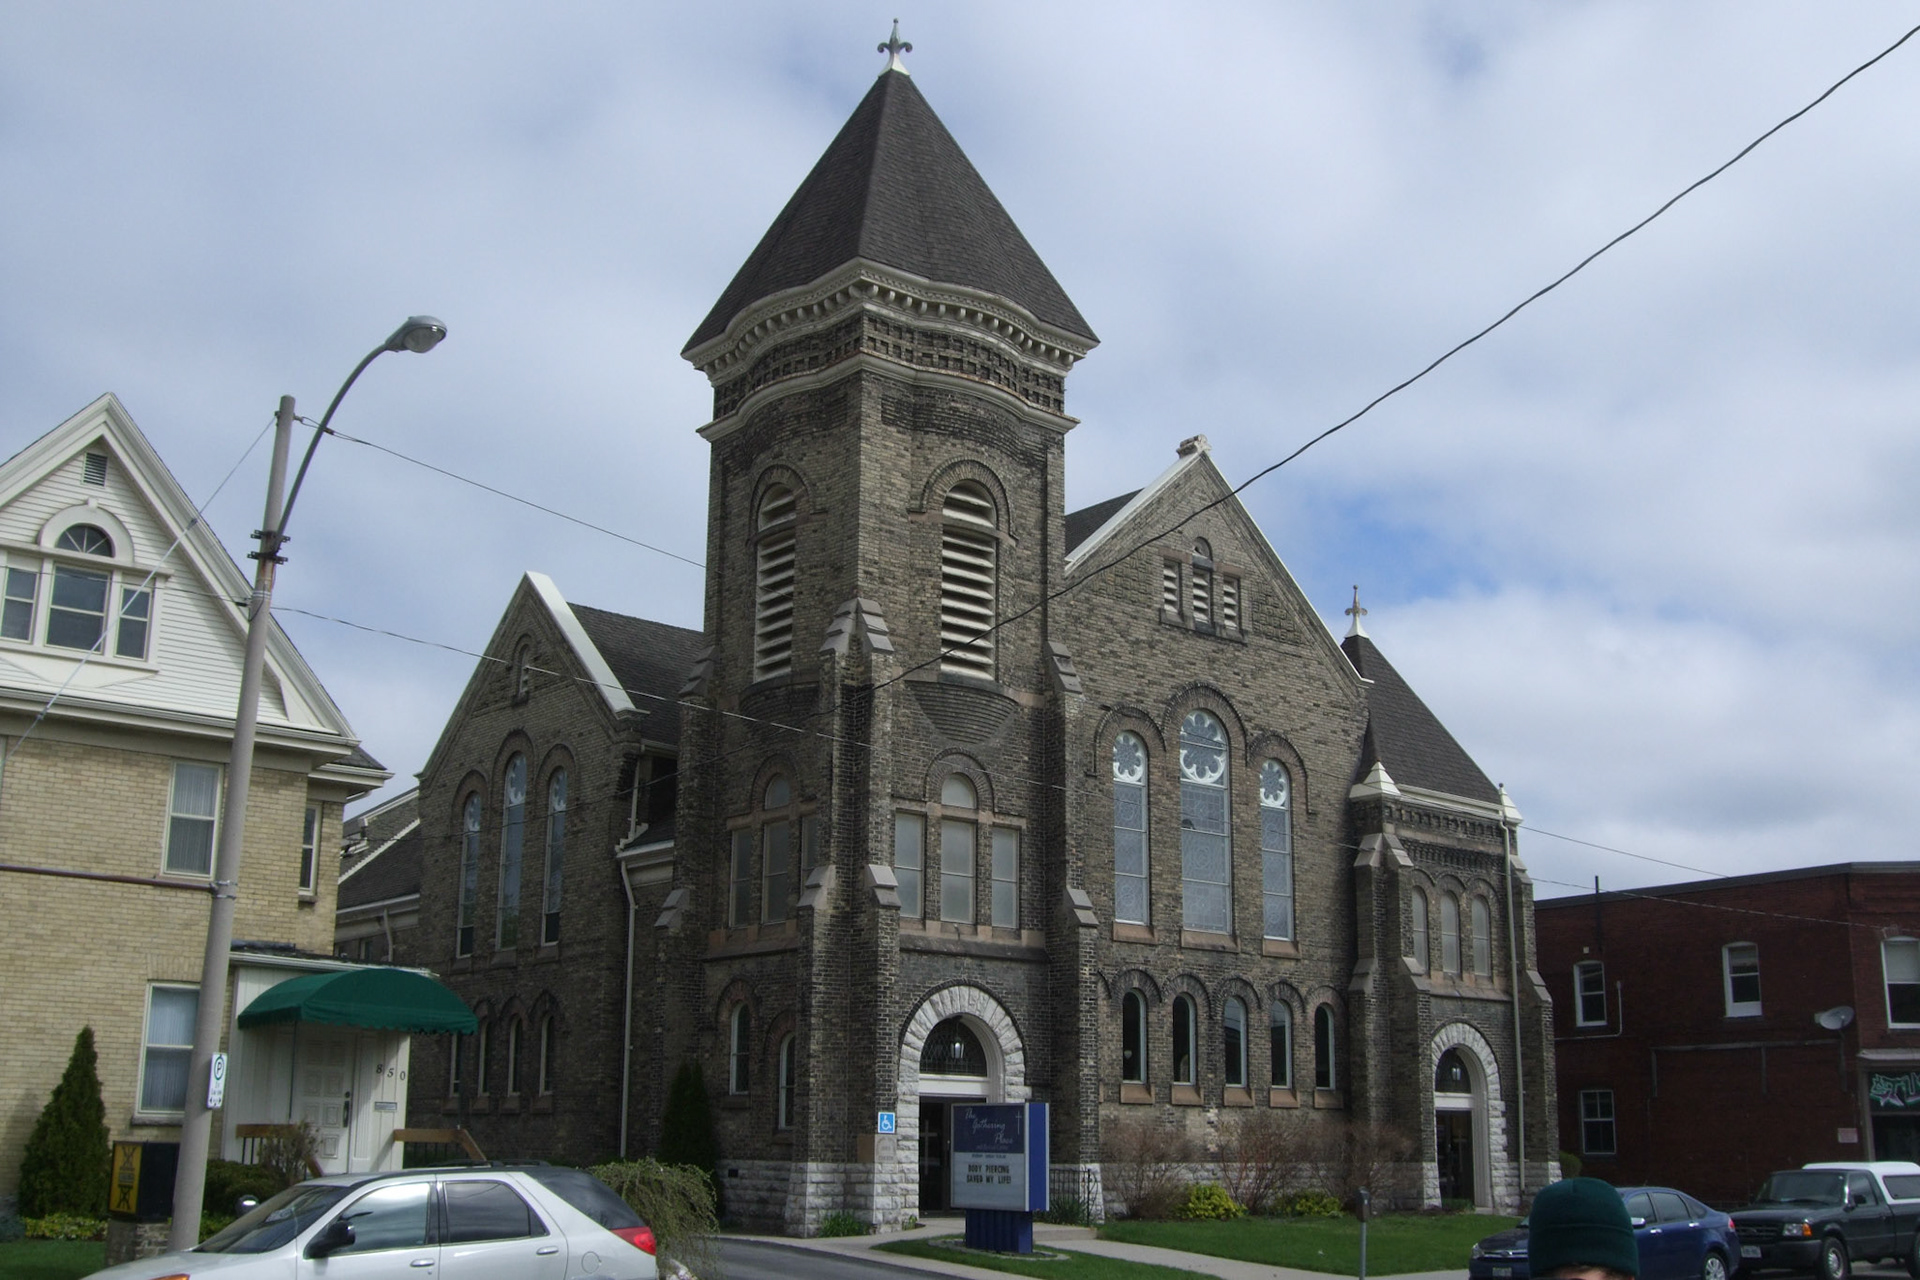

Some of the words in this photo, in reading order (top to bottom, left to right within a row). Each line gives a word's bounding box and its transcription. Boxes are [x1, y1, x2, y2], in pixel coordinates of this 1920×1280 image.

[376, 1064, 406, 1081] 850
[968, 1164, 982, 1173] BODY
[985, 1165, 1009, 1174] PIERCING
[967, 1174, 983, 1184] SAVED
[986, 1175, 994, 1184] MY
